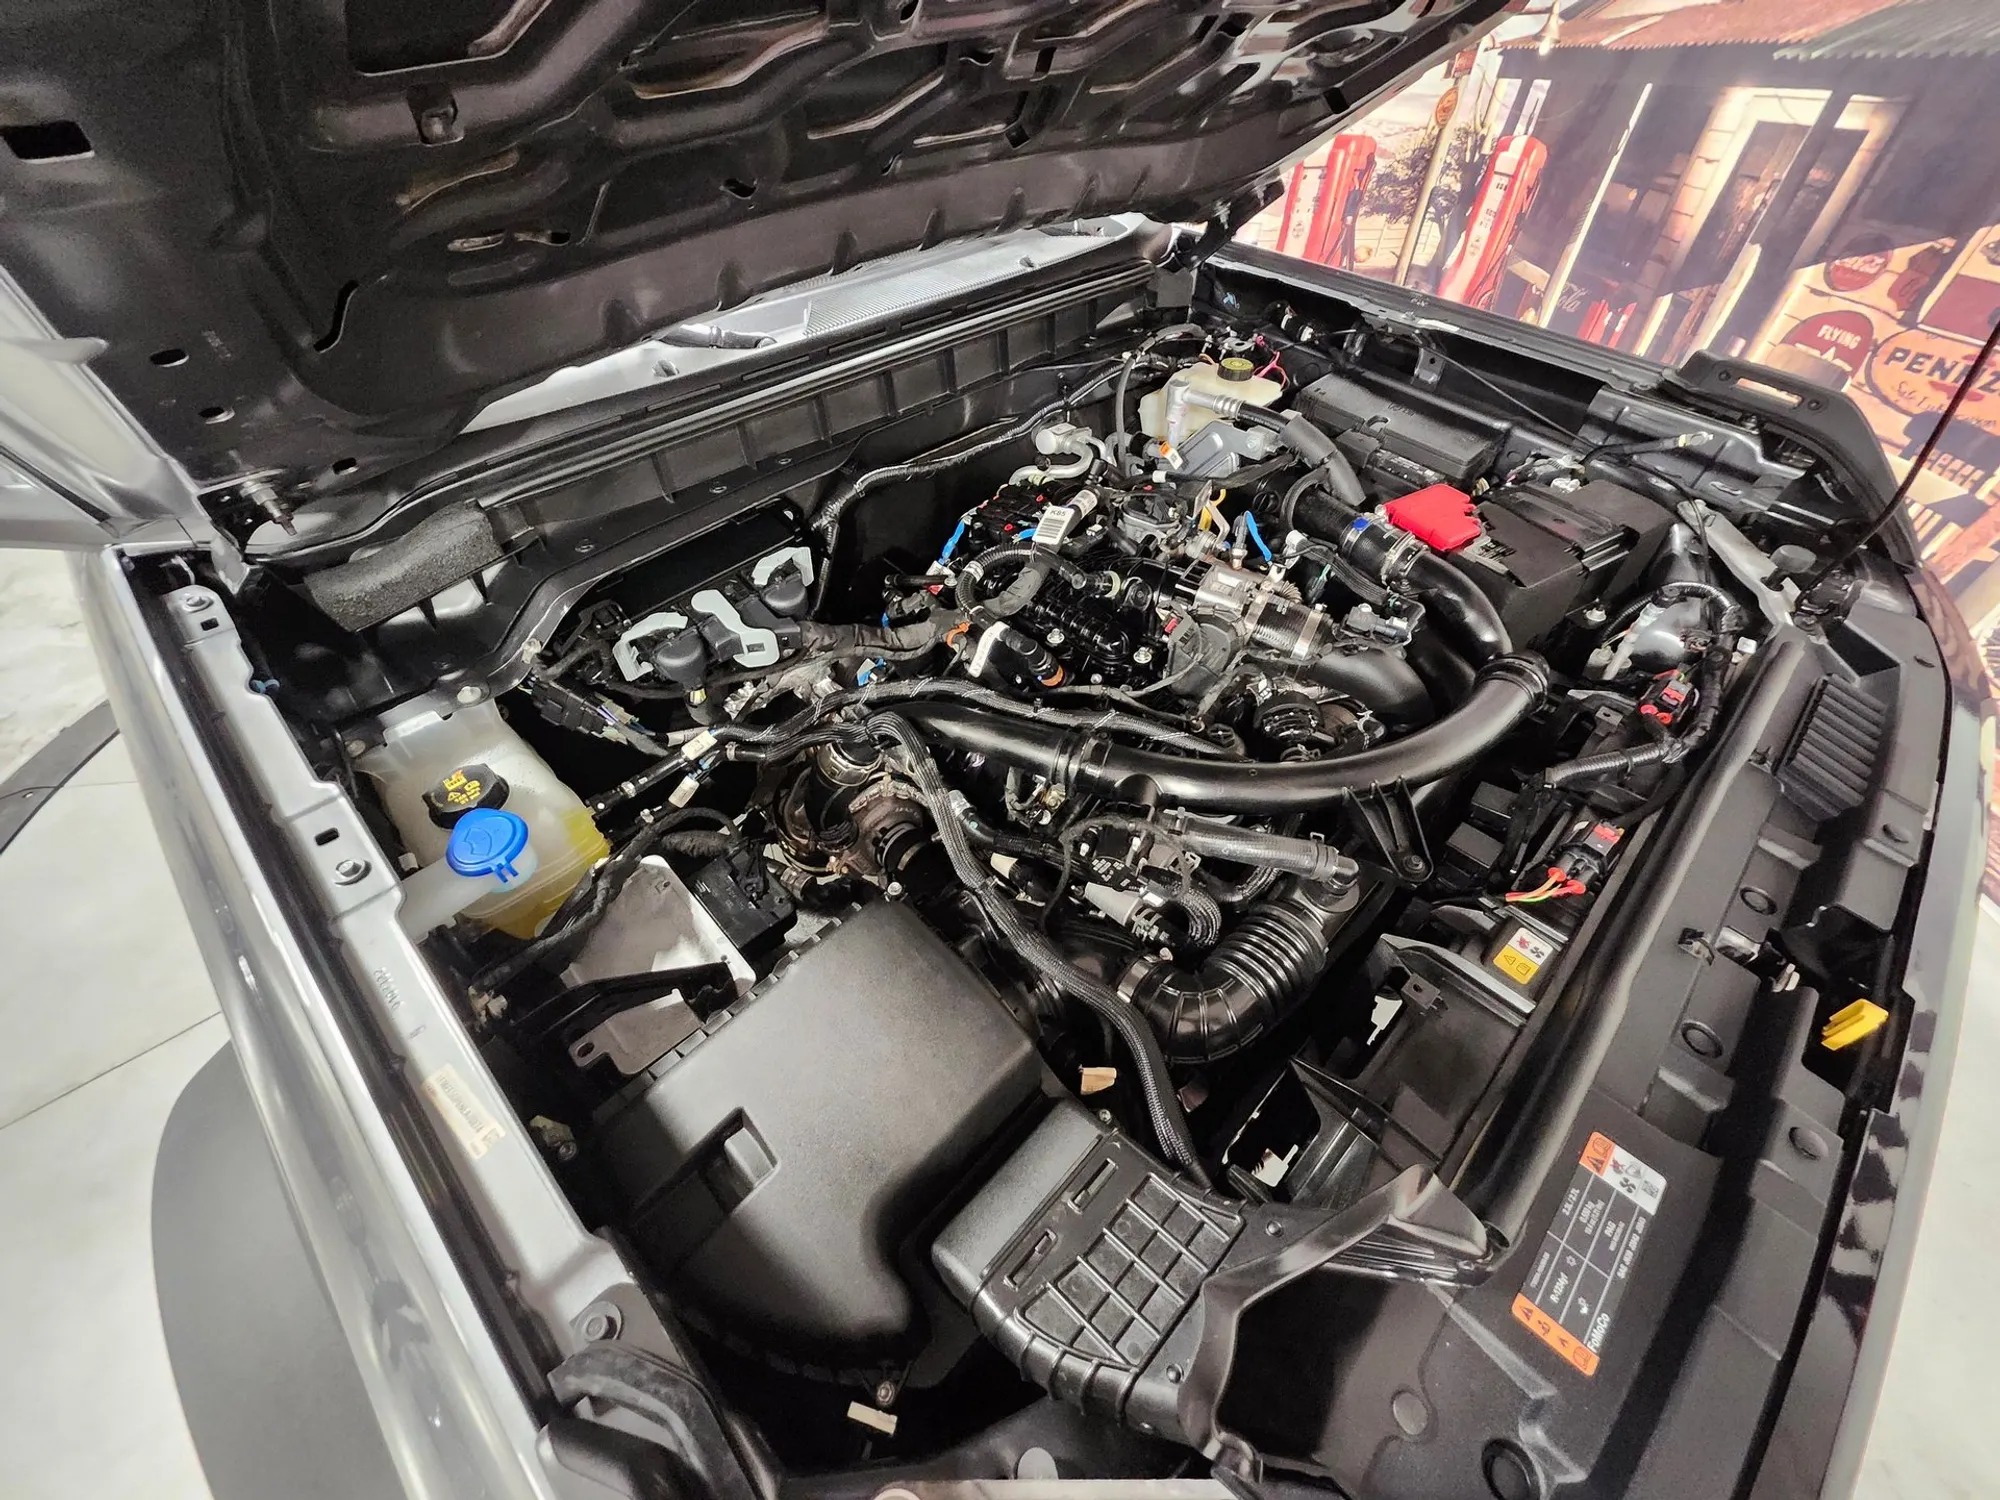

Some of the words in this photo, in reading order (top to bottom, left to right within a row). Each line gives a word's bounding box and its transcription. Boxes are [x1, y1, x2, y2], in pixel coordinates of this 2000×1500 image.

[1817, 325, 1861, 349] FLYING
[1551, 1272, 1568, 1304] R-1234yf
[1587, 1313, 1610, 1353] FoMoCo
